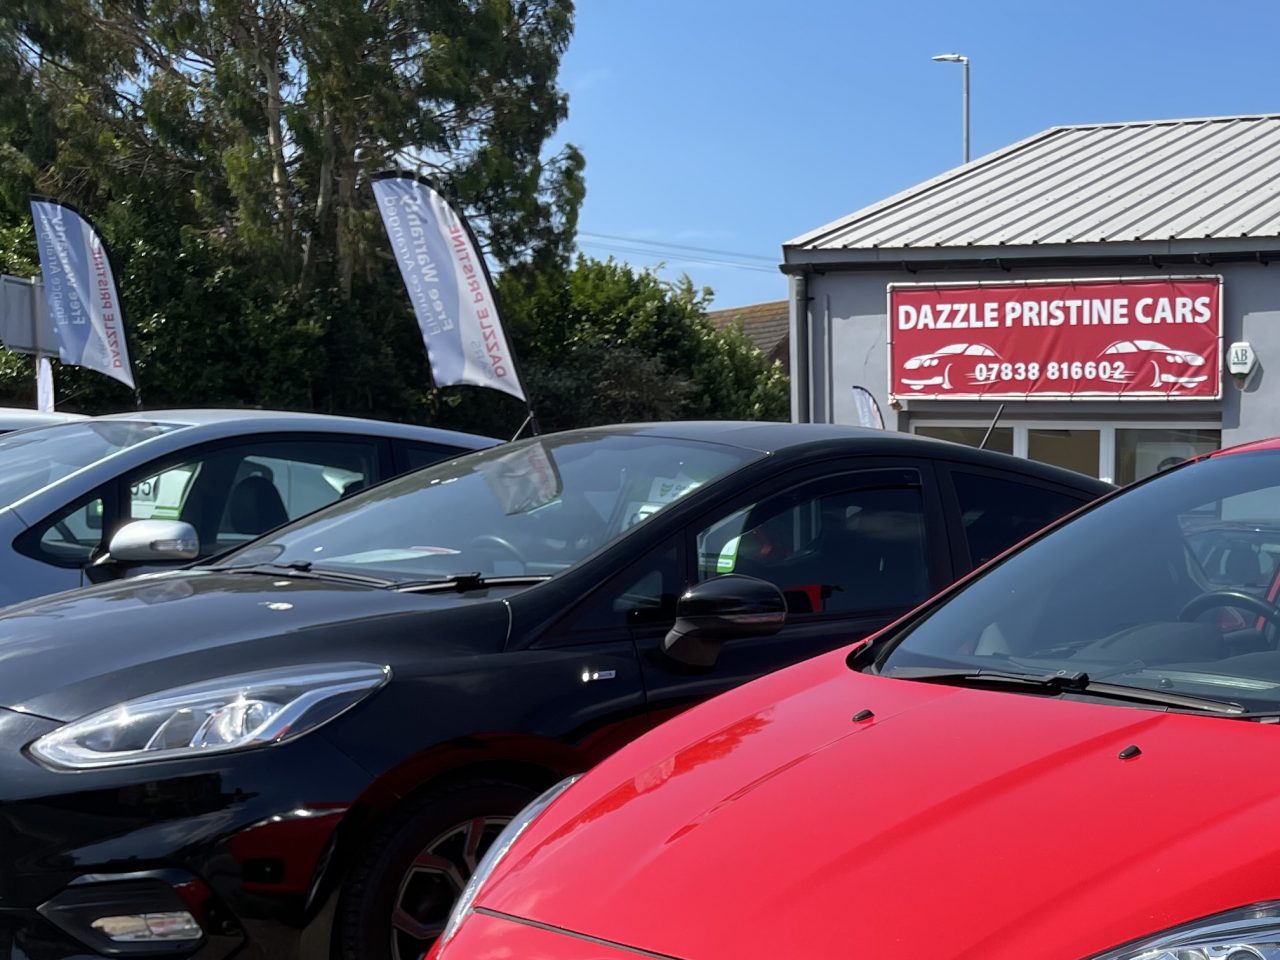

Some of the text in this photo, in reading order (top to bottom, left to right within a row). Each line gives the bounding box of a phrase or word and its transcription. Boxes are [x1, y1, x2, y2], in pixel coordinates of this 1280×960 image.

[898, 296, 1211, 330] DAZZLE PRISTINE CARS
[975, 361, 1125, 381] 07838 816602
